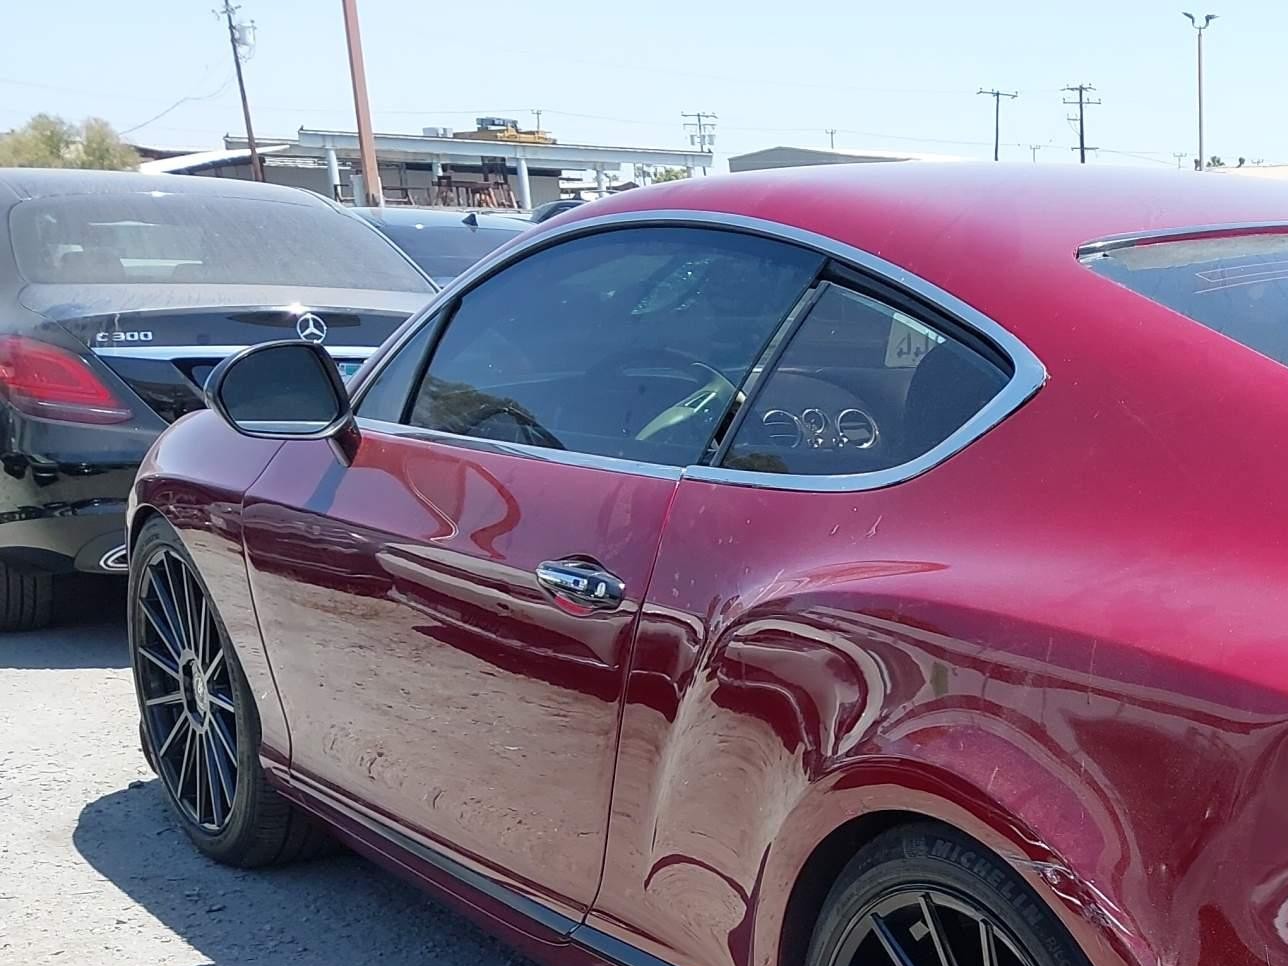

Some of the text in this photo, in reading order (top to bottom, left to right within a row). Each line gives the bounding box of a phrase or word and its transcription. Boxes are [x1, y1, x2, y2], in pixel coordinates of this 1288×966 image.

[96, 331, 152, 342] C 300
[930, 838, 1044, 926] MICHELIN
